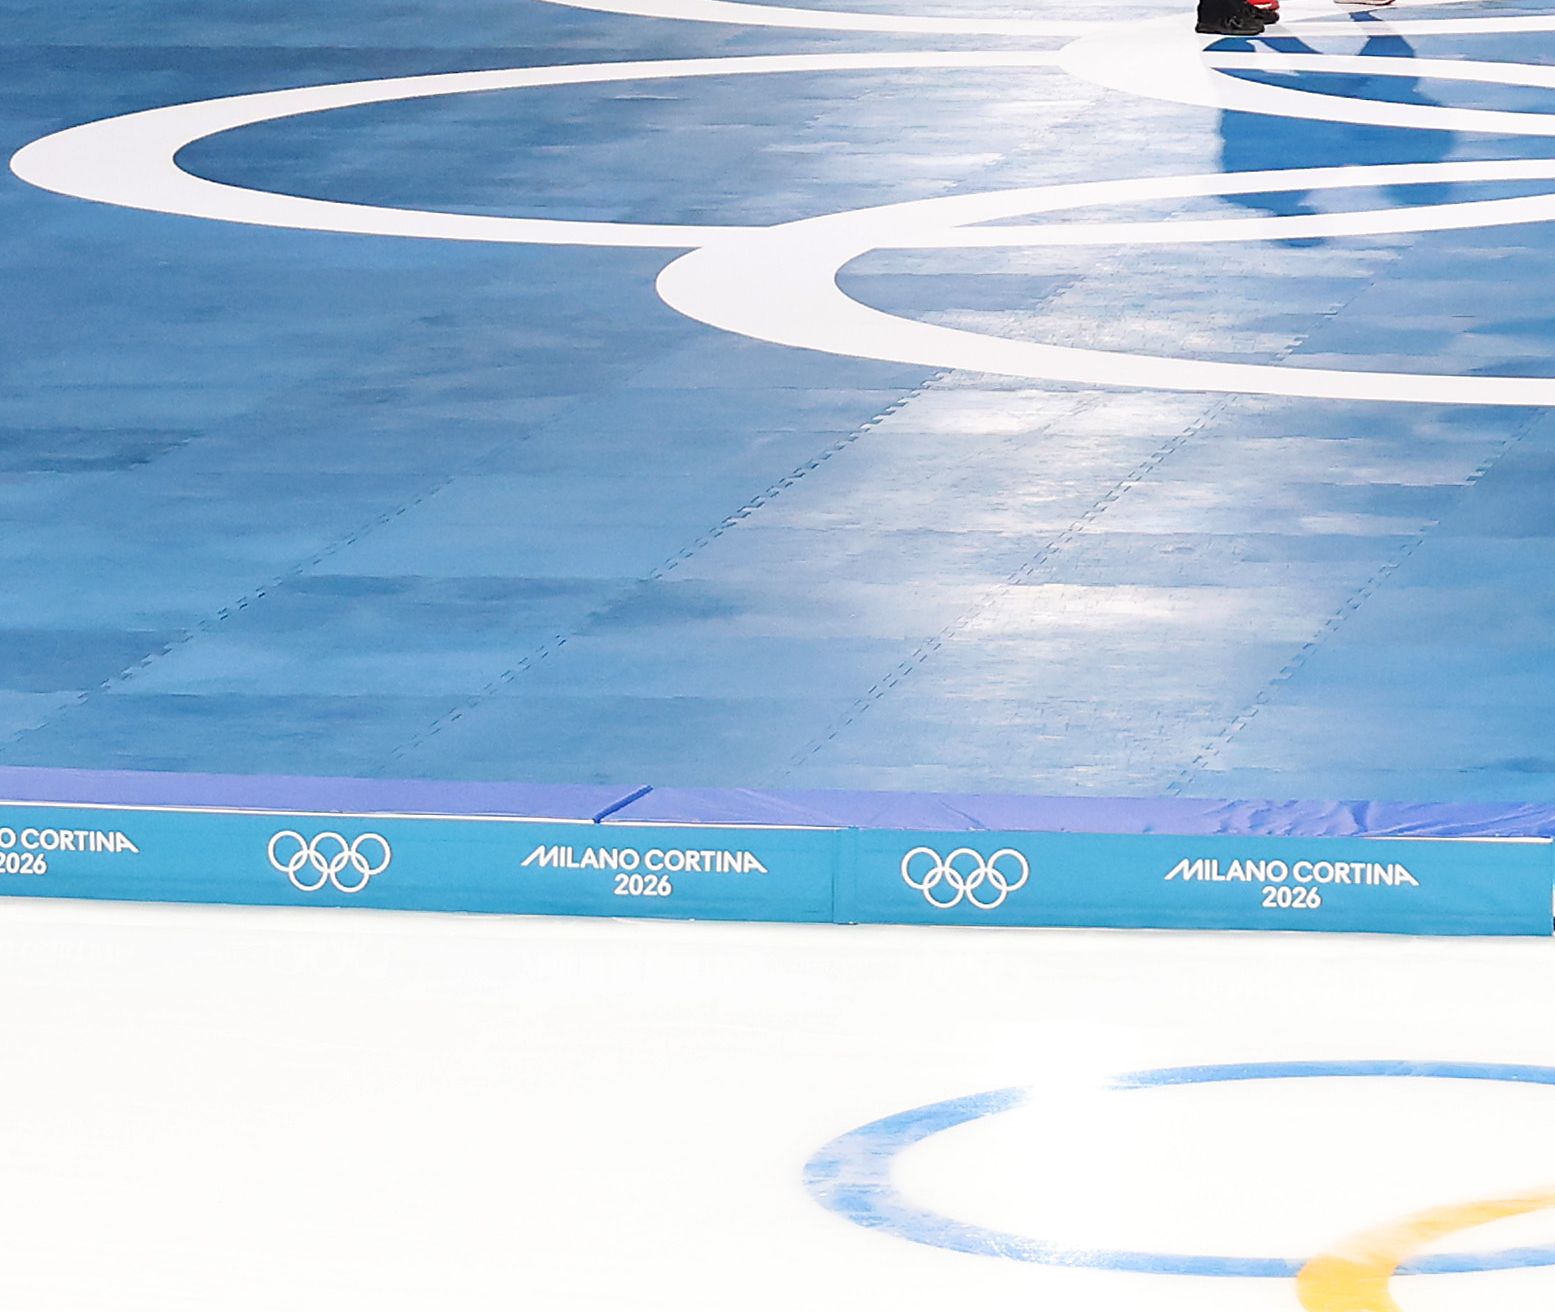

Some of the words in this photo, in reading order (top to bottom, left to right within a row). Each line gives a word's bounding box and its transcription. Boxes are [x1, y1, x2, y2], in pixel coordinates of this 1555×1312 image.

[21, 828, 140, 853] CORTINA
[521, 846, 640, 870] MILANO
[644, 850, 767, 873] CORTINA
[1165, 859, 1288, 882] MILANO
[1293, 861, 1419, 885] CORTINA
[614, 873, 671, 896] 2026
[1262, 885, 1321, 908] 2026
